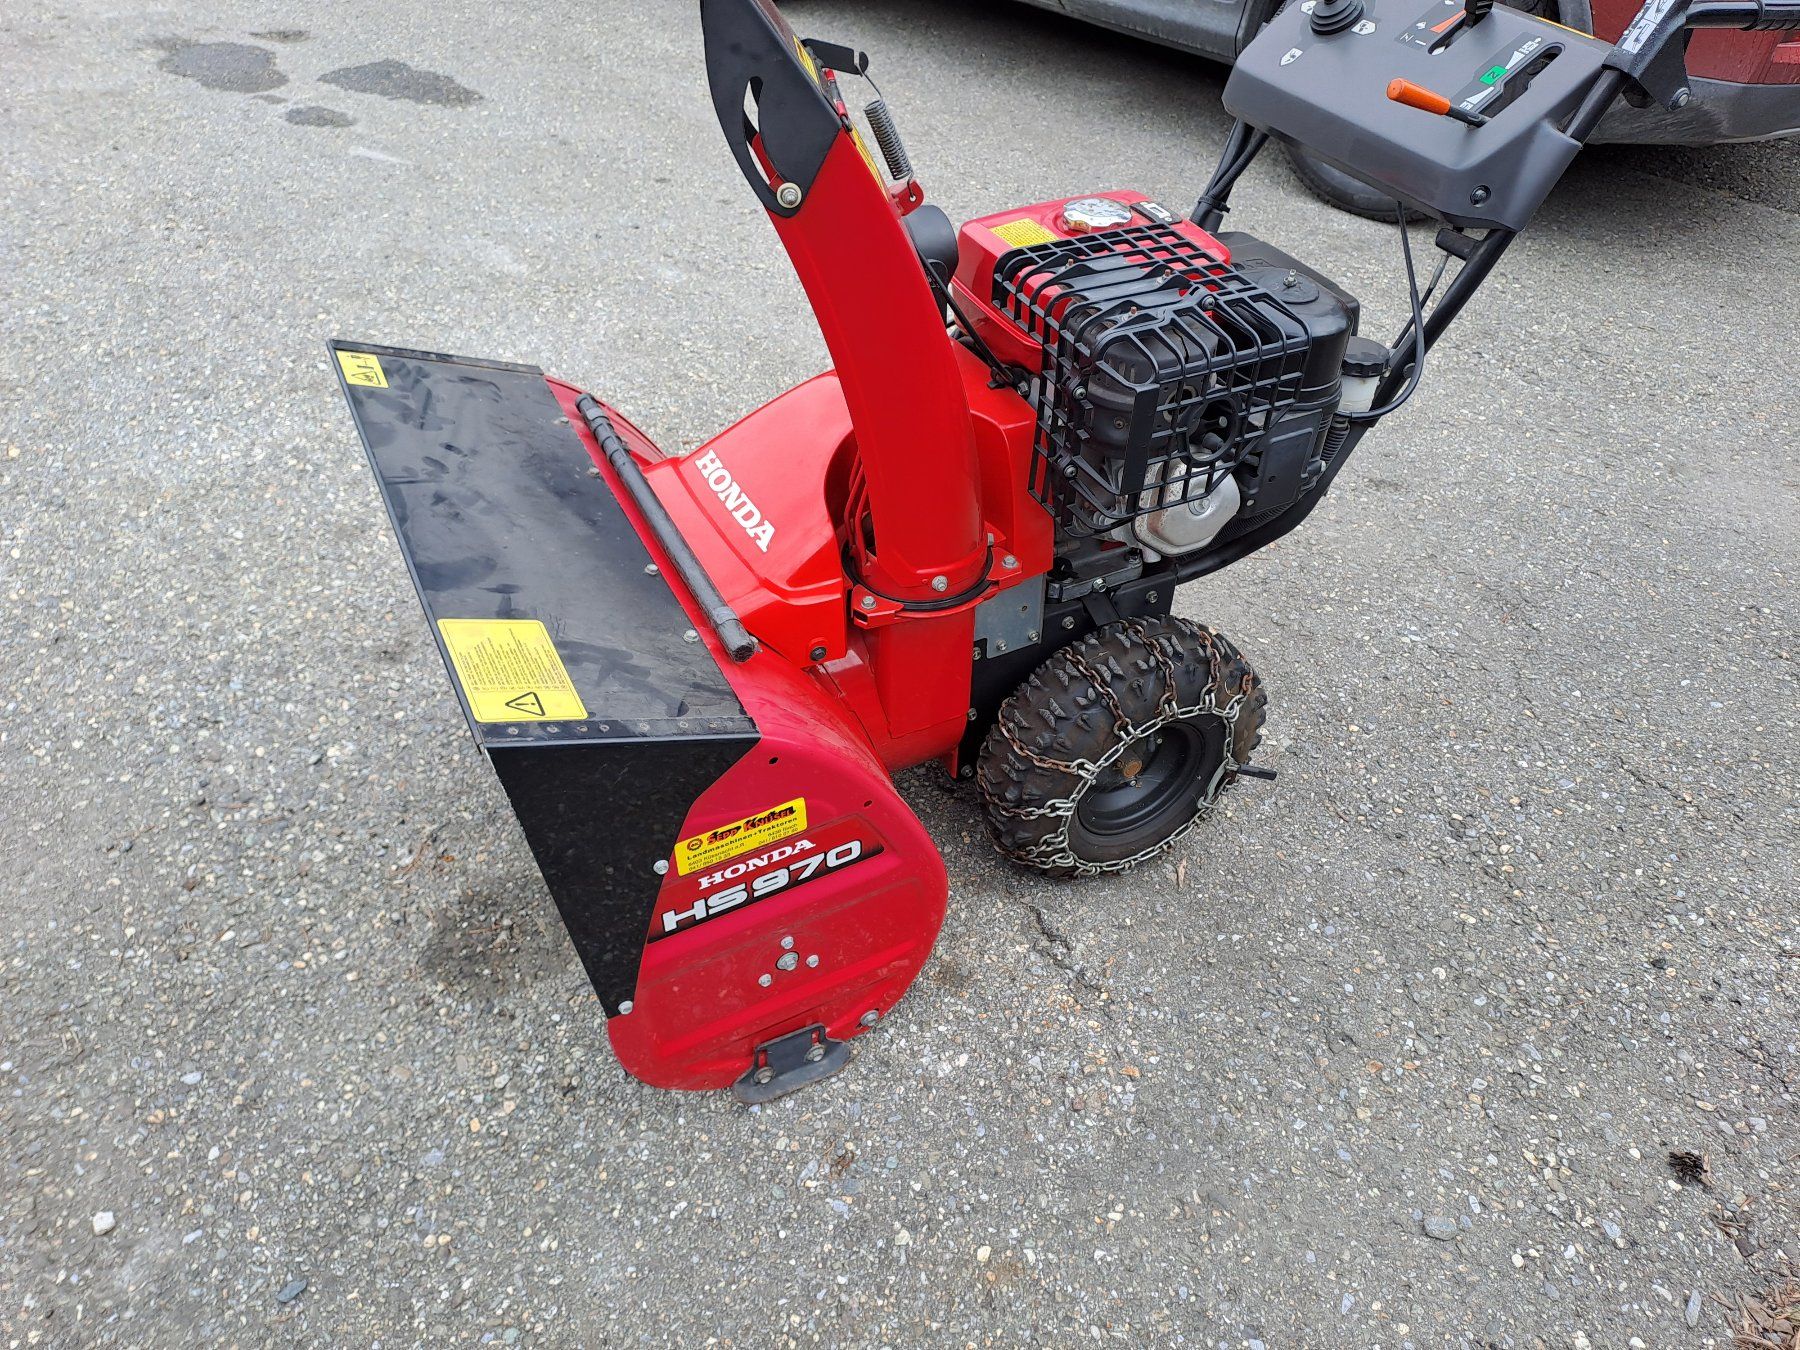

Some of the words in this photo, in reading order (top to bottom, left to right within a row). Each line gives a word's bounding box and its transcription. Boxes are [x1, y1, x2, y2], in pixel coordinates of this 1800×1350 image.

[694, 449, 775, 552] HONDA
[662, 840, 862, 933] HS970
[698, 839, 816, 890] HONDA
